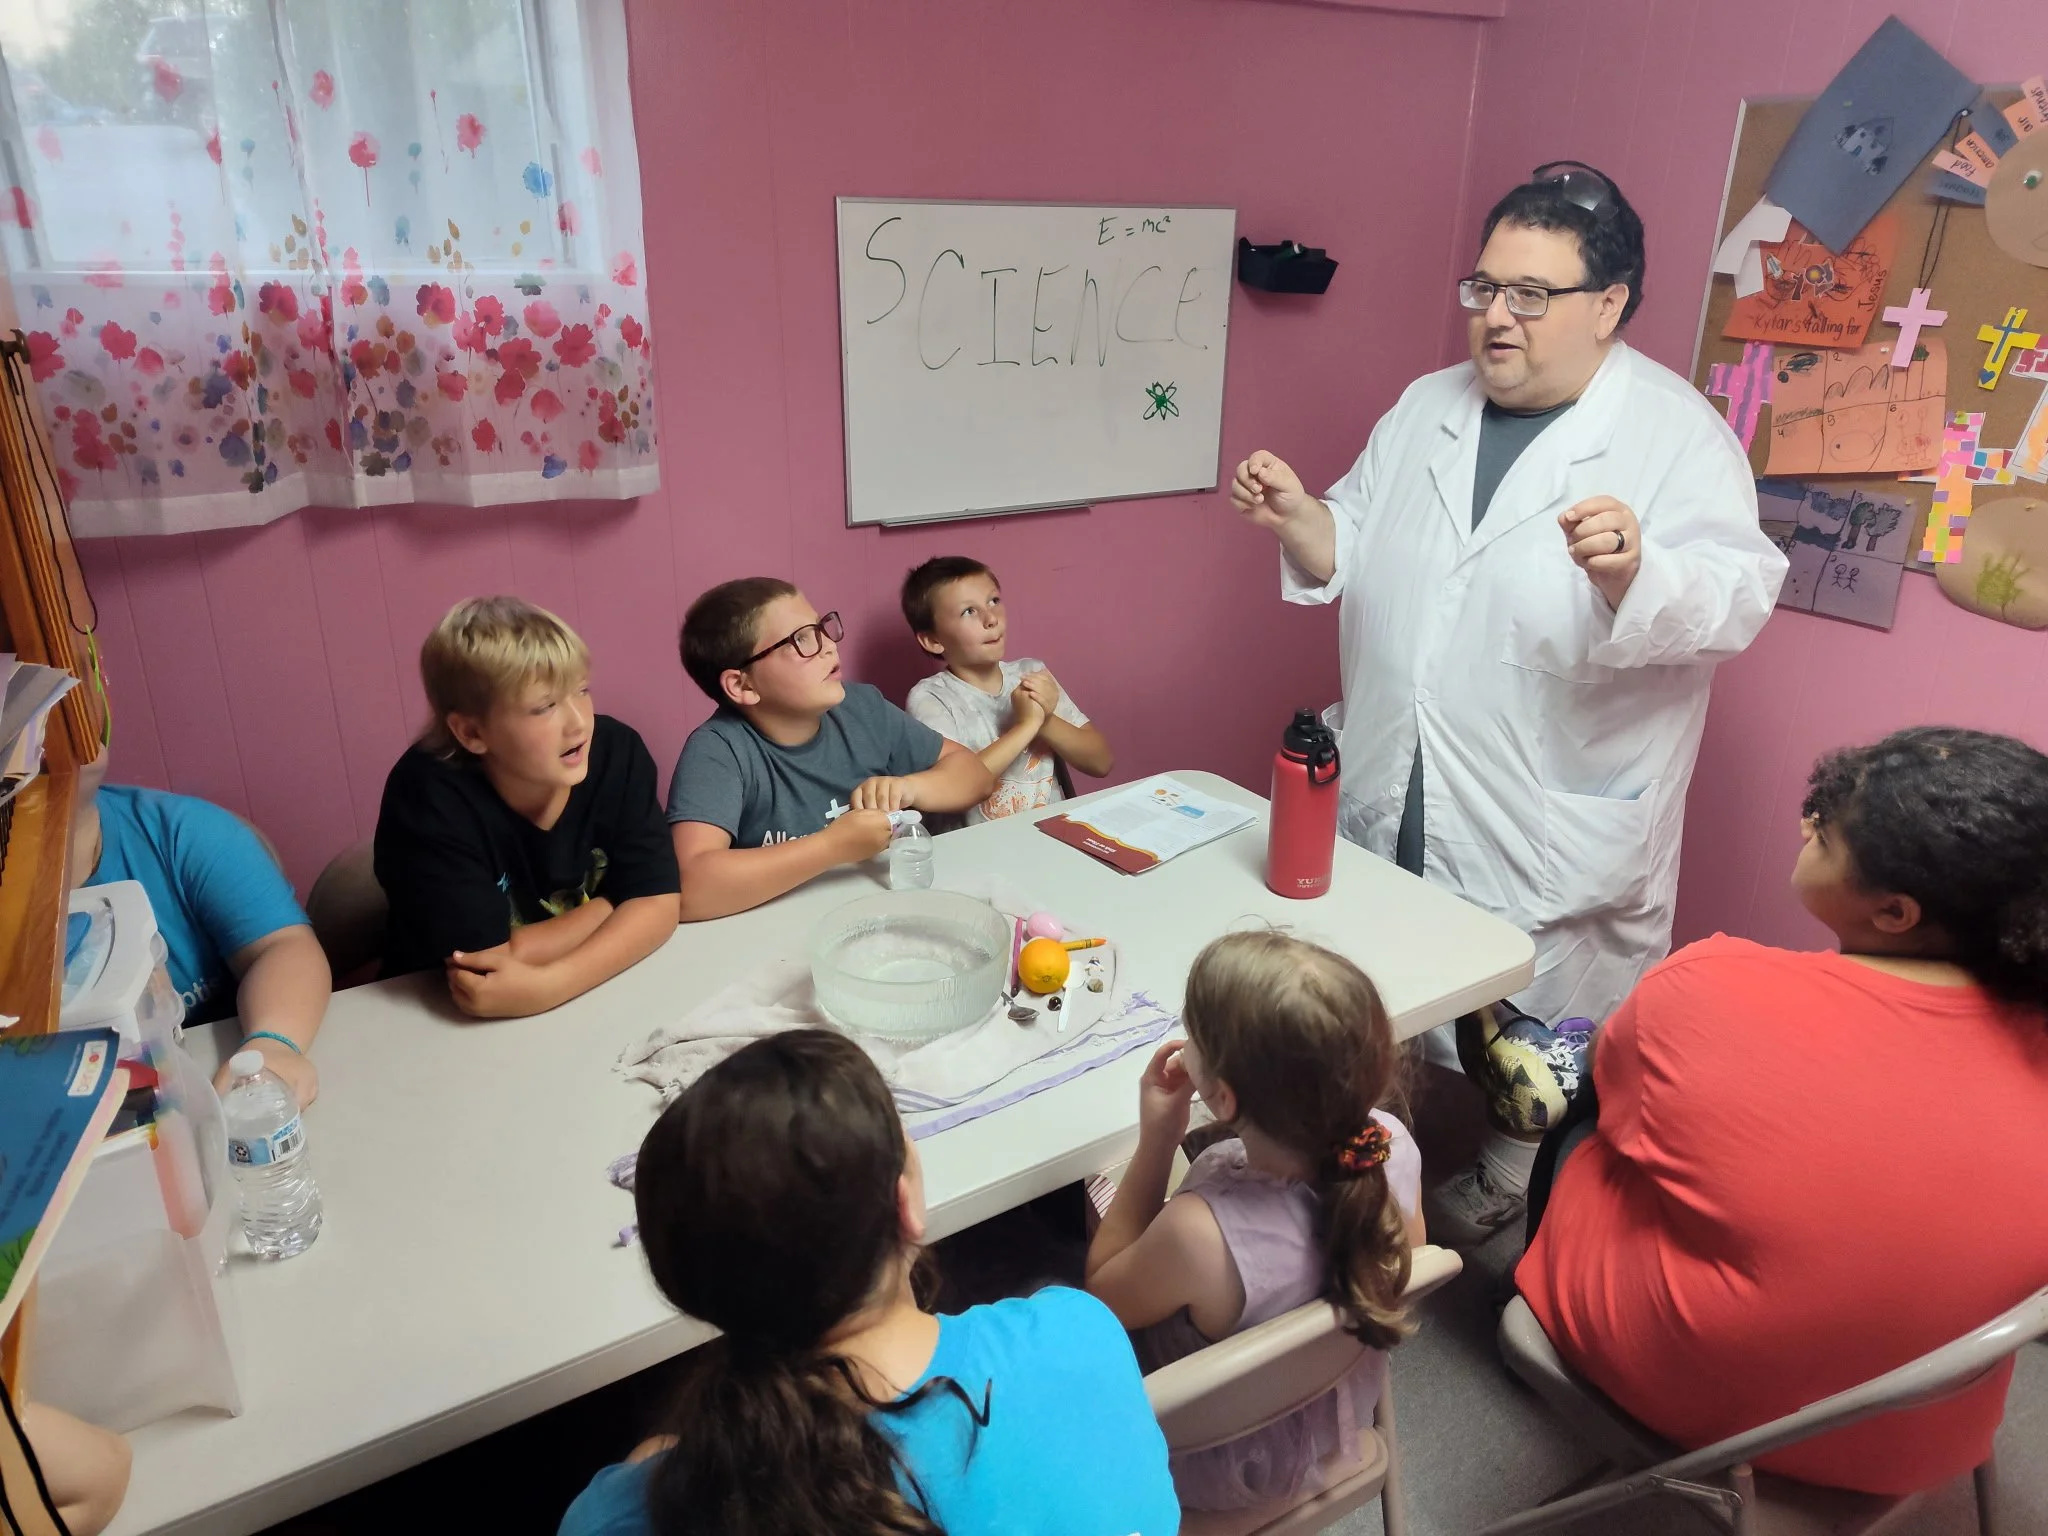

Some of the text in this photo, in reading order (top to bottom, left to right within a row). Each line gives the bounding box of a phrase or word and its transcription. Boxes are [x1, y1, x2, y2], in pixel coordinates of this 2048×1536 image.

[1098, 216, 1118, 245] E
[1858, 270, 1887, 312] Jesus
[1846, 316, 1861, 335] for
[1833, 352, 1842, 362] 2
